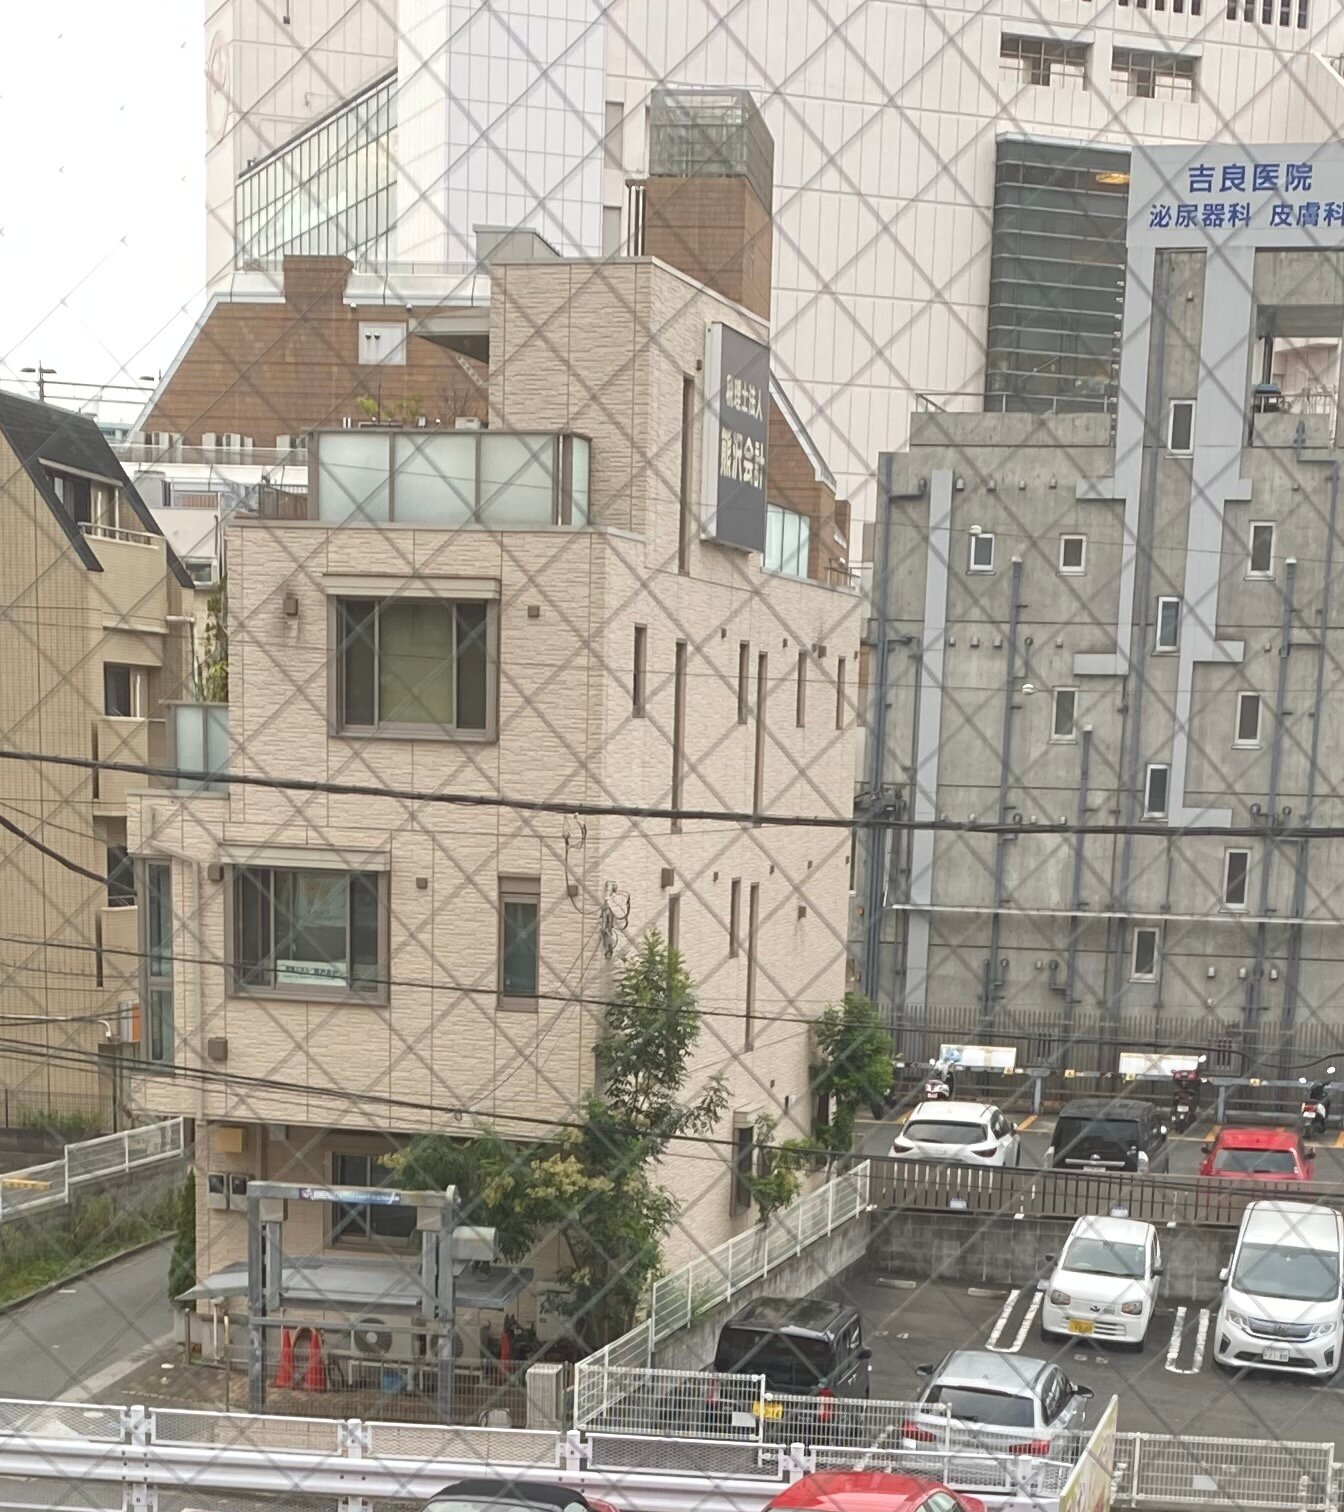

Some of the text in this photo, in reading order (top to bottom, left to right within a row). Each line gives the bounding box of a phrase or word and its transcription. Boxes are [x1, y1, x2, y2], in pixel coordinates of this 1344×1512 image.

[1187, 161, 1315, 194] 吉良医院
[1148, 201, 1253, 230] 泌尿器科
